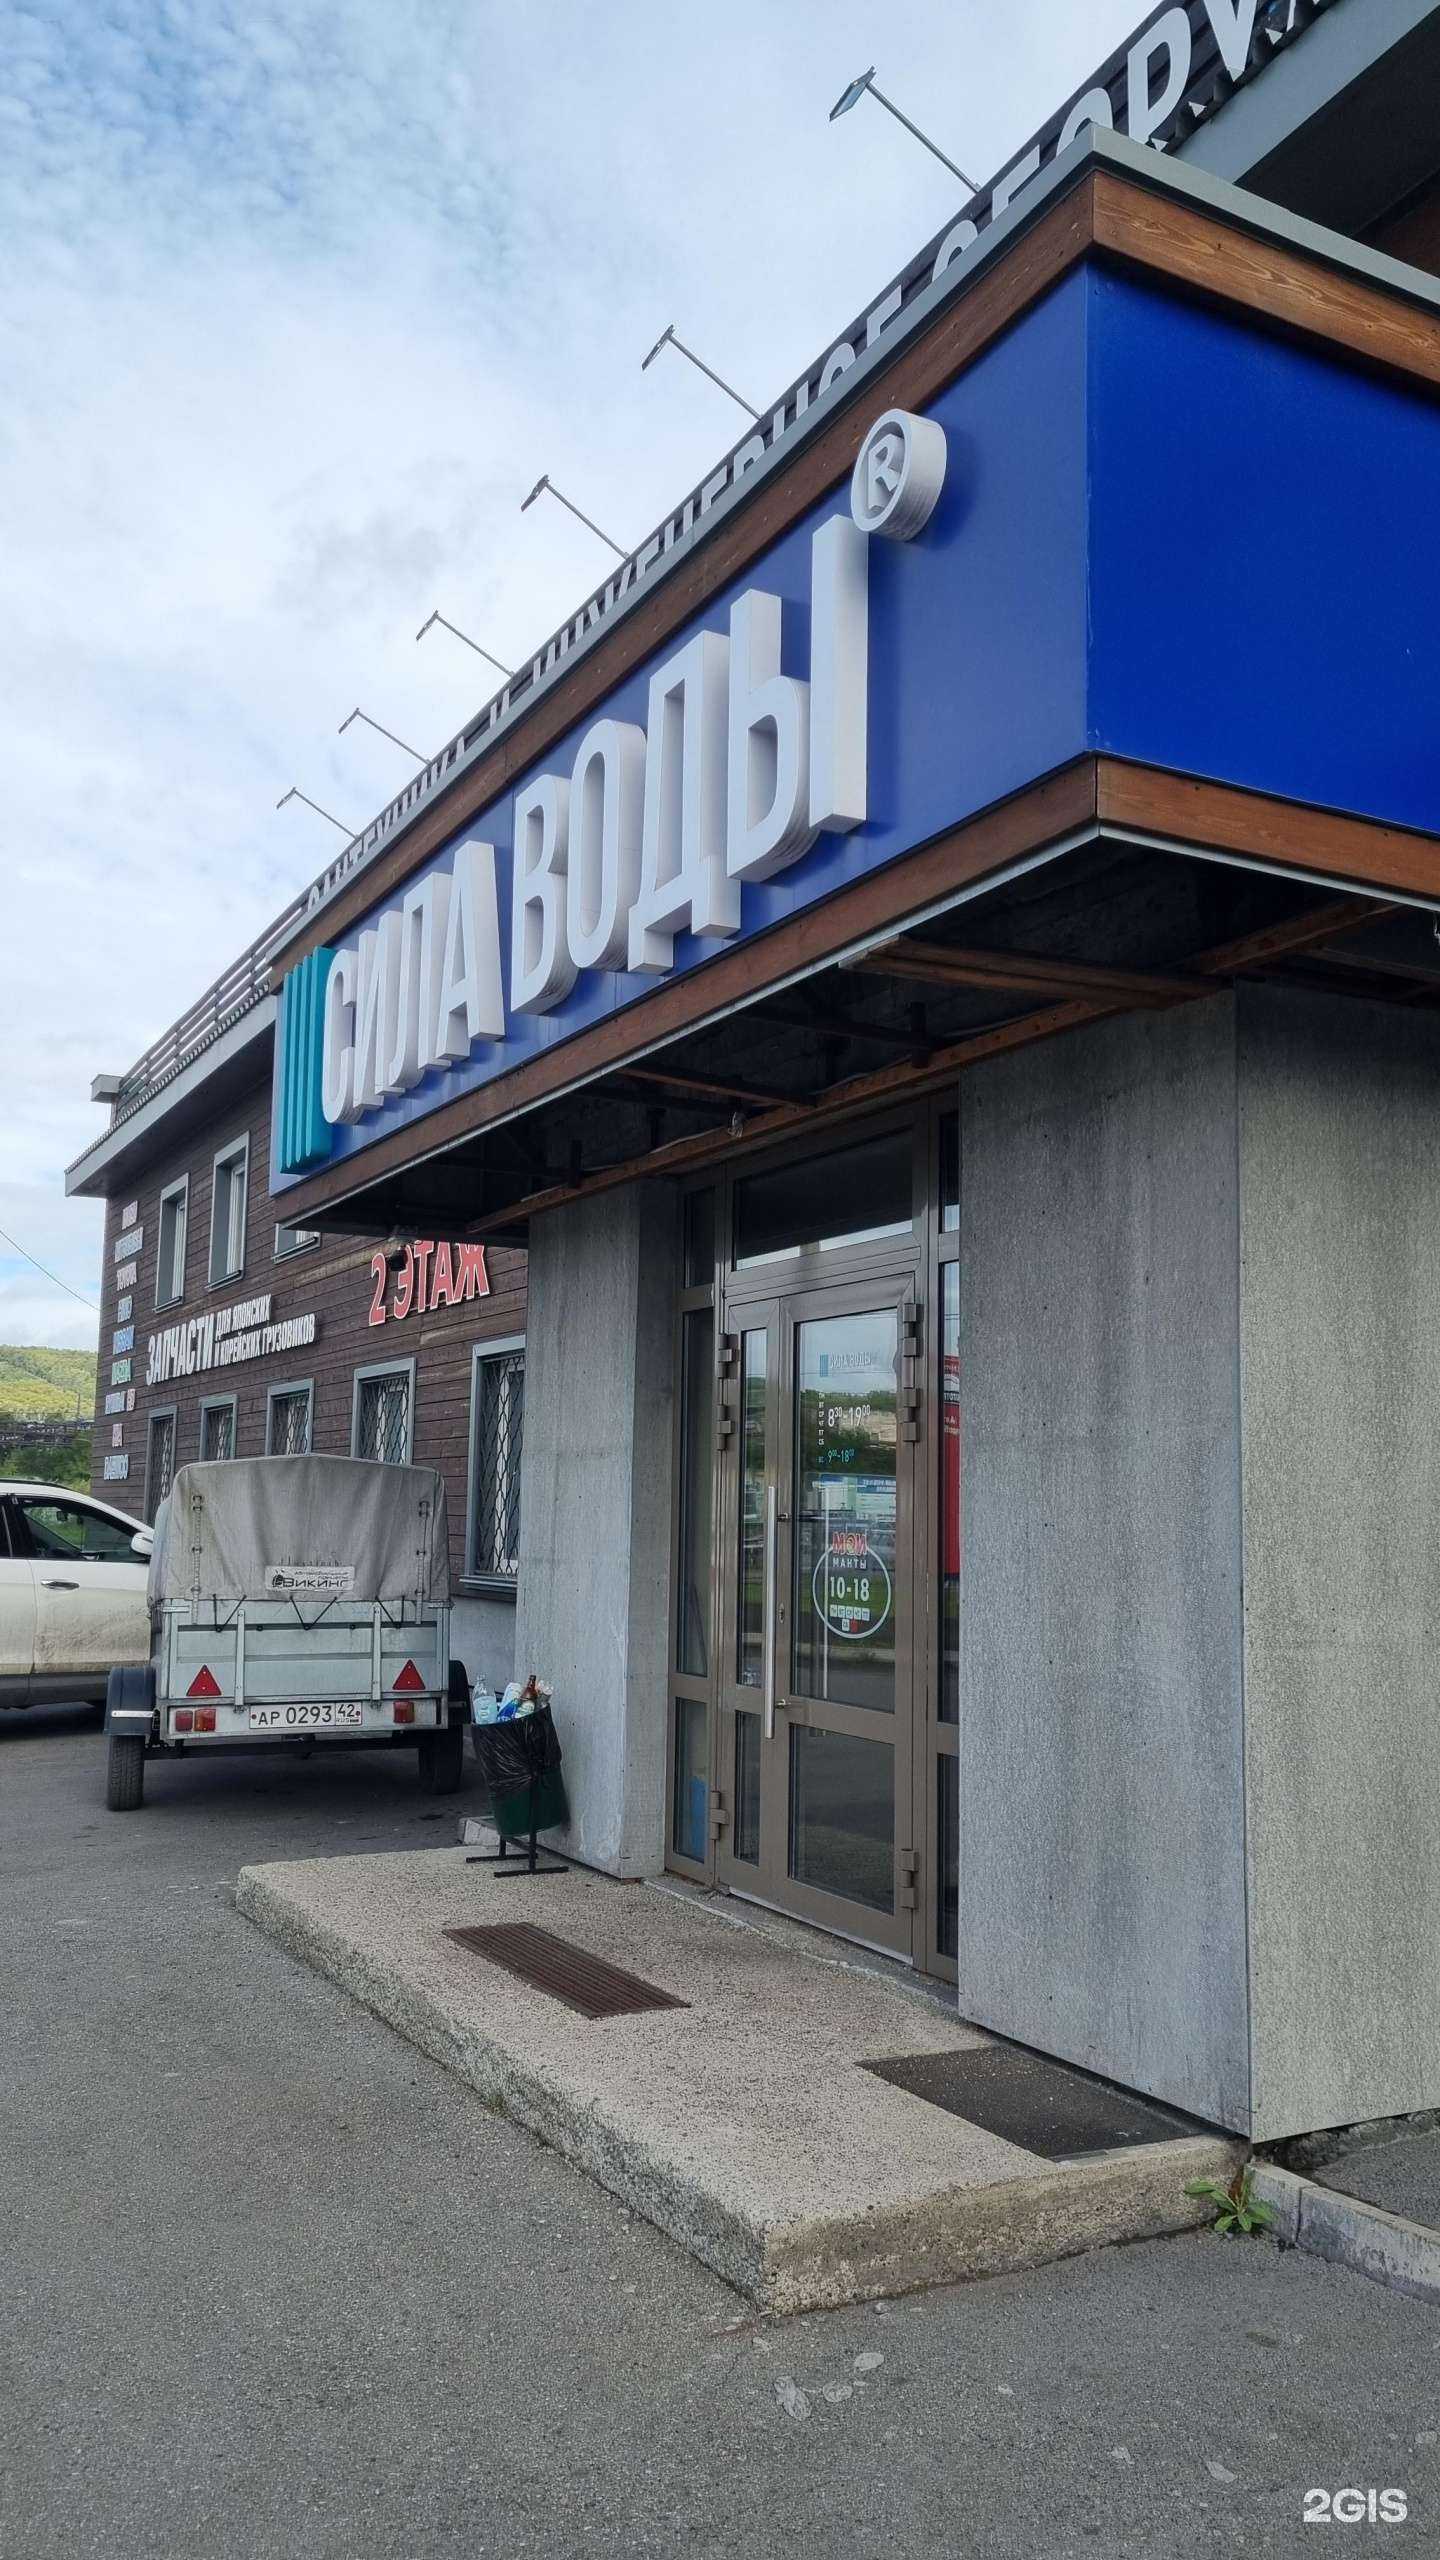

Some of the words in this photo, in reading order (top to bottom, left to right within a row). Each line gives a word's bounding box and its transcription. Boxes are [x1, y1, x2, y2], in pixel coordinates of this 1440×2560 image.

[323, 841, 505, 1124] СИЛА
[511, 514, 868, 1015] ВОДЫ
[369, 1252, 386, 1326] 2
[394, 1239, 490, 1319] ЭТАЖ
[146, 1313, 214, 1386] ЗАПЧАСТИ
[215, 1307, 232, 1341] ДЛЯ
[231, 1294, 272, 1331] ЯПОНСКИХ
[214, 1341, 219, 1367] И
[219, 1330, 261, 1365] КОРЕЙСКИХ
[261, 1313, 315, 1355] ГРУЗОВИКОВ
[830, 1576, 870, 1601] 10-18
[832, 1557, 867, 1570] МАНТЫ
[286, 1705, 332, 1724] 0293
[337, 1703, 355, 1718] 42
